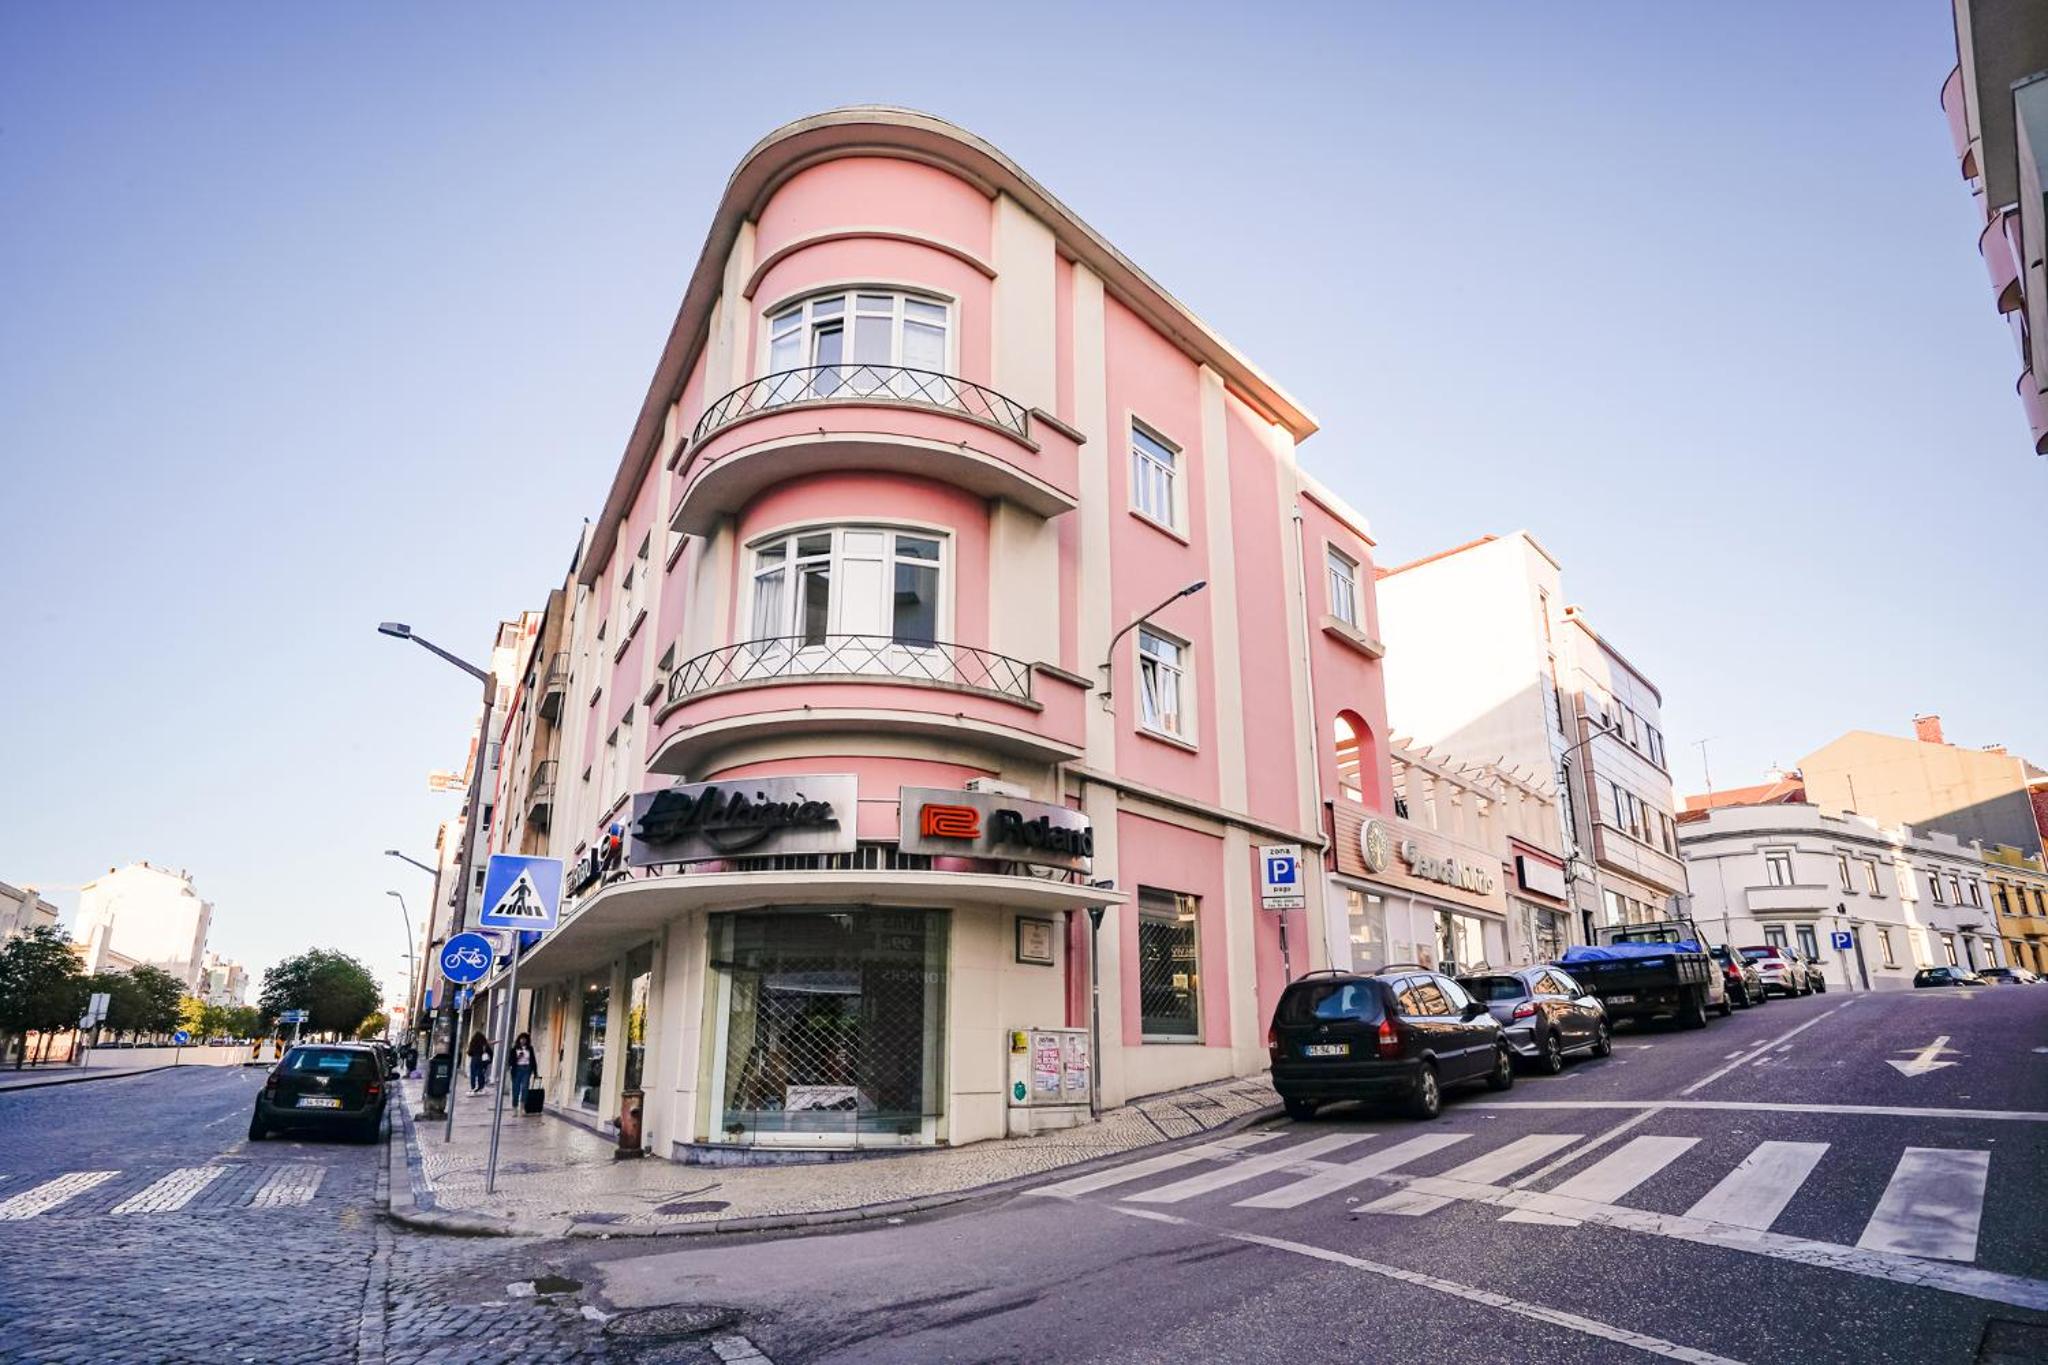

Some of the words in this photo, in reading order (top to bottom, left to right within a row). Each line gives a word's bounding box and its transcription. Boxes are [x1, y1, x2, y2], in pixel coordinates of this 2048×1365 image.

[996, 809, 1093, 857] Roland
[1273, 860, 1289, 882] P
[1835, 933, 1848, 948] P
